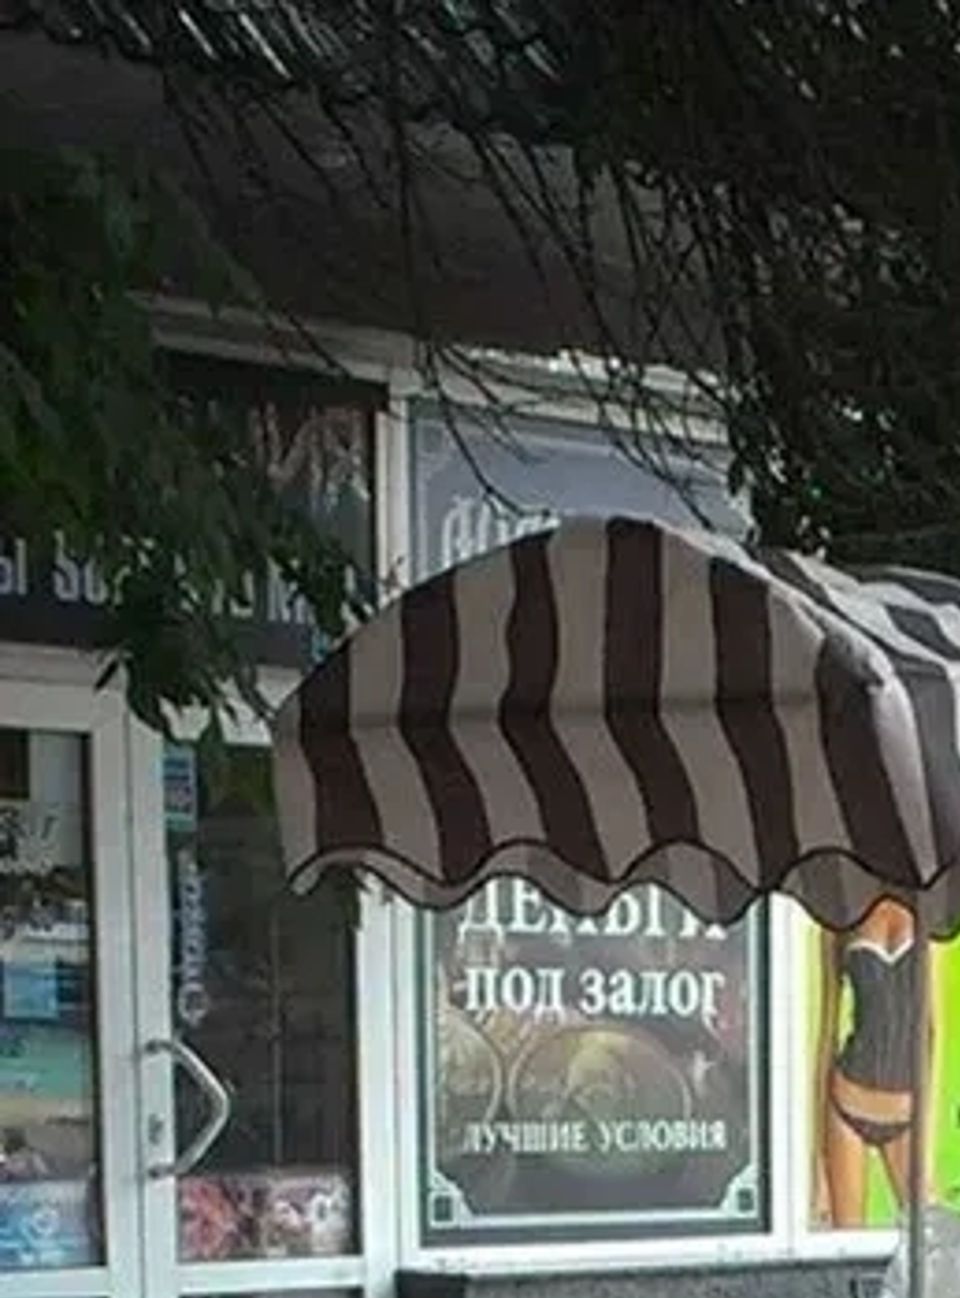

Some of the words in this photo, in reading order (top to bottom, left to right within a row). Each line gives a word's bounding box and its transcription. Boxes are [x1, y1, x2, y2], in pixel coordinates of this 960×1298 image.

[463, 966, 566, 1022] под
[578, 968, 727, 1017] залог
[461, 1121, 588, 1154] ЛУЧШИЕ
[599, 1121, 728, 1152] УСЛОВИЯ
